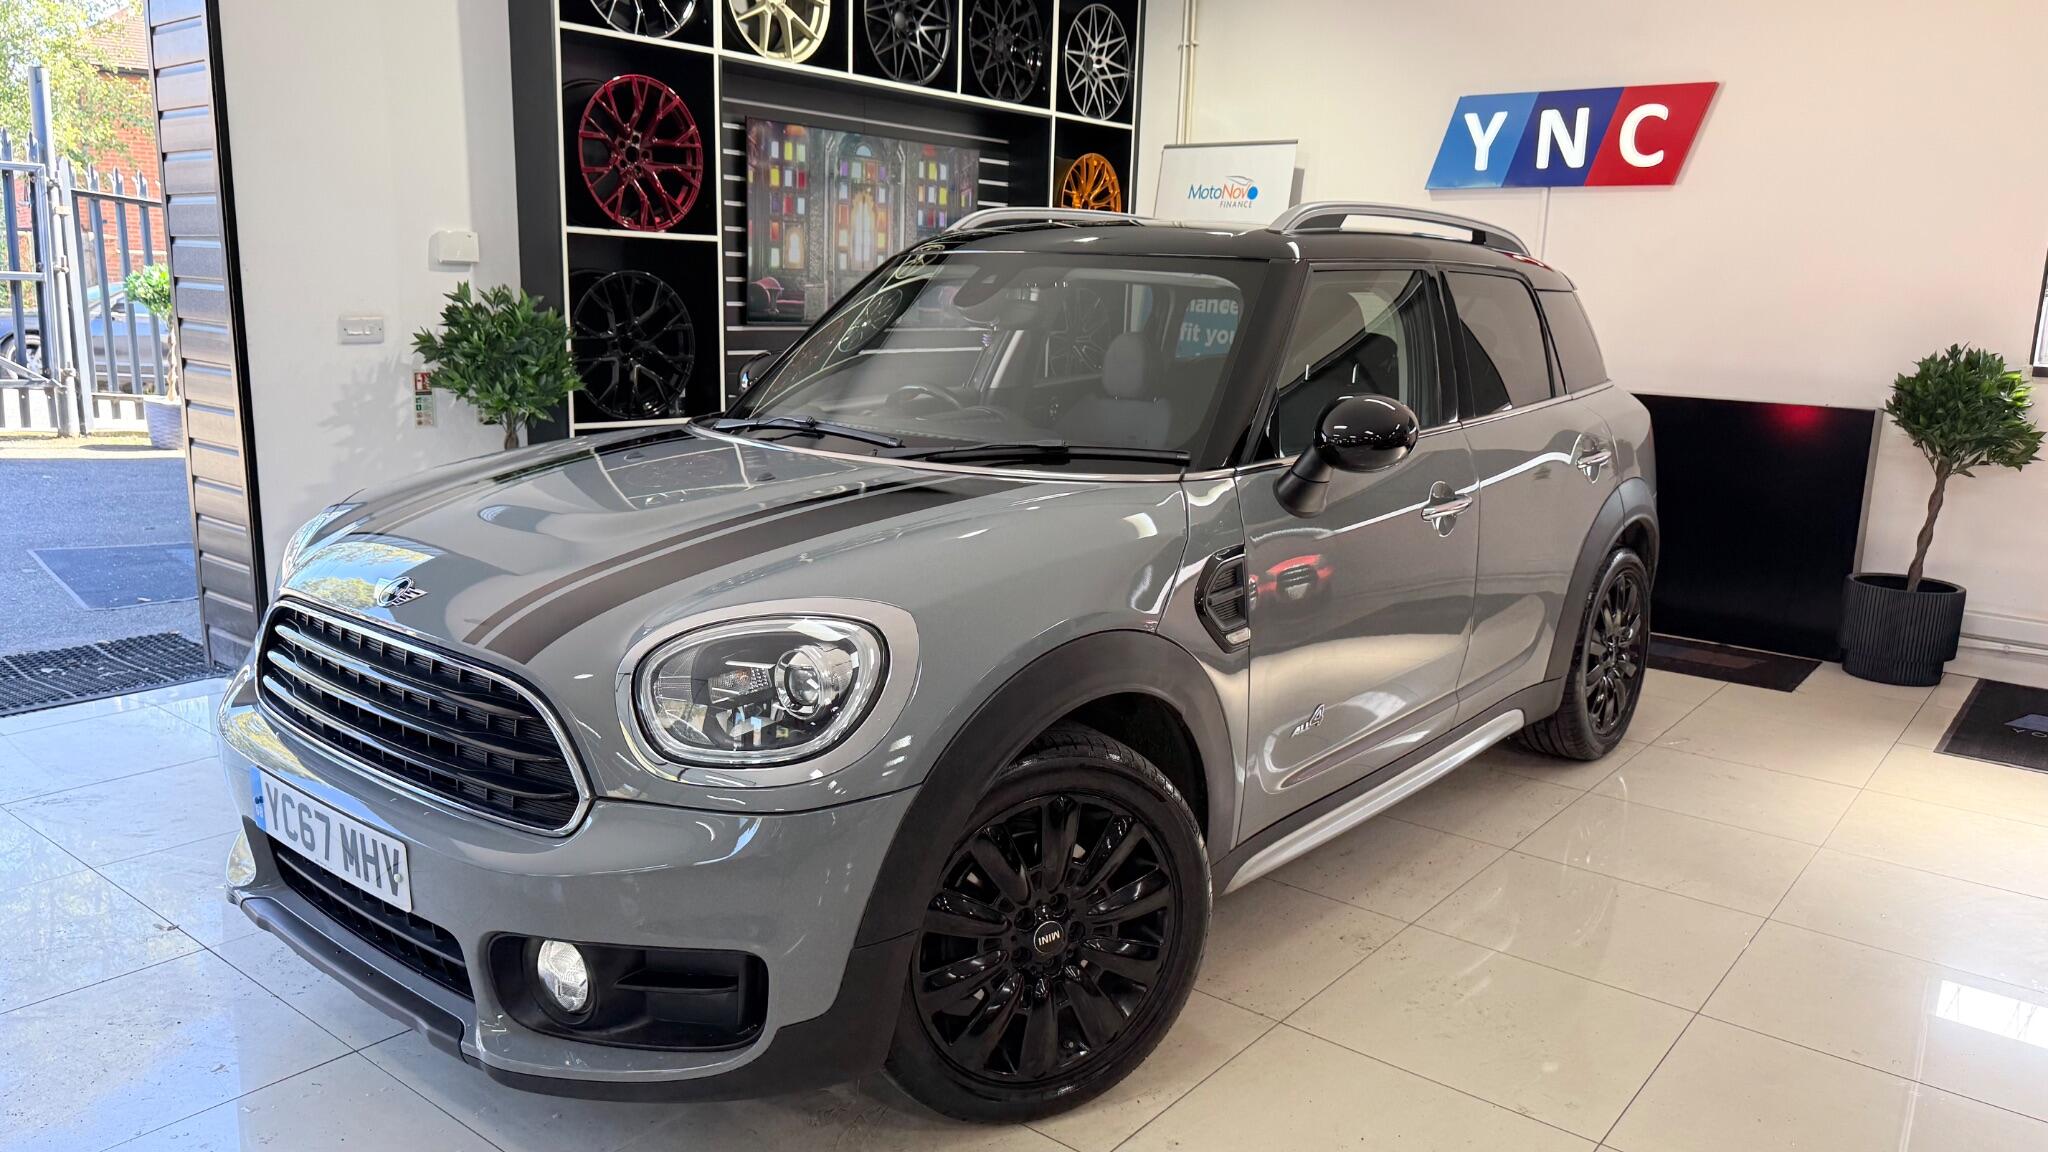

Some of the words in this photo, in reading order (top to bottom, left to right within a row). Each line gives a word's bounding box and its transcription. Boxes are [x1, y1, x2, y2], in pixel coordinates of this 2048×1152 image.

[1464, 103, 1669, 171] YNC
[1187, 183, 1258, 200] MotoNovo
[1219, 200, 1253, 208] FINANCE
[265, 782, 330, 861] YC67
[339, 823, 399, 897] MHV
[1038, 929, 1061, 946] MINI
